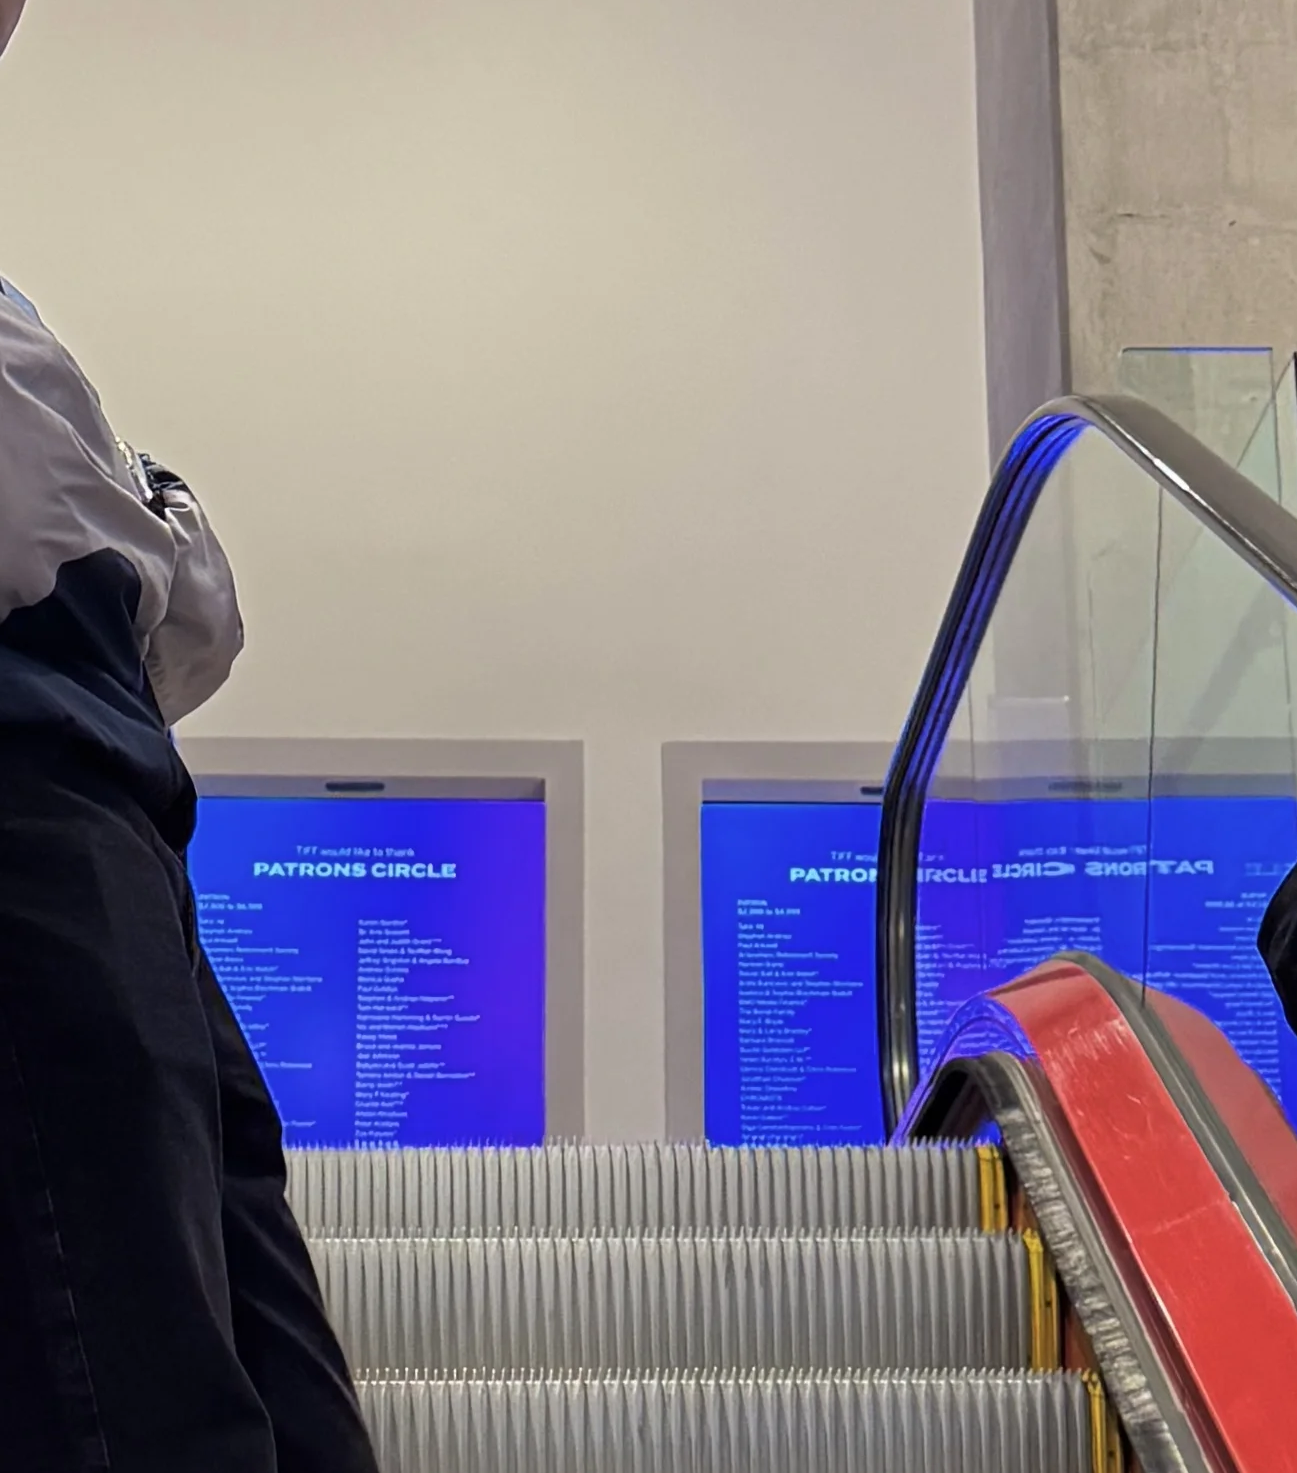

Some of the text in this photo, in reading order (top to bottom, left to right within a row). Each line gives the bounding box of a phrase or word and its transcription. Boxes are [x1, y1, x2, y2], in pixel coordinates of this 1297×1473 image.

[254, 862, 457, 878] PATRONS CIRCLE
[917, 868, 988, 883] IRCLE
